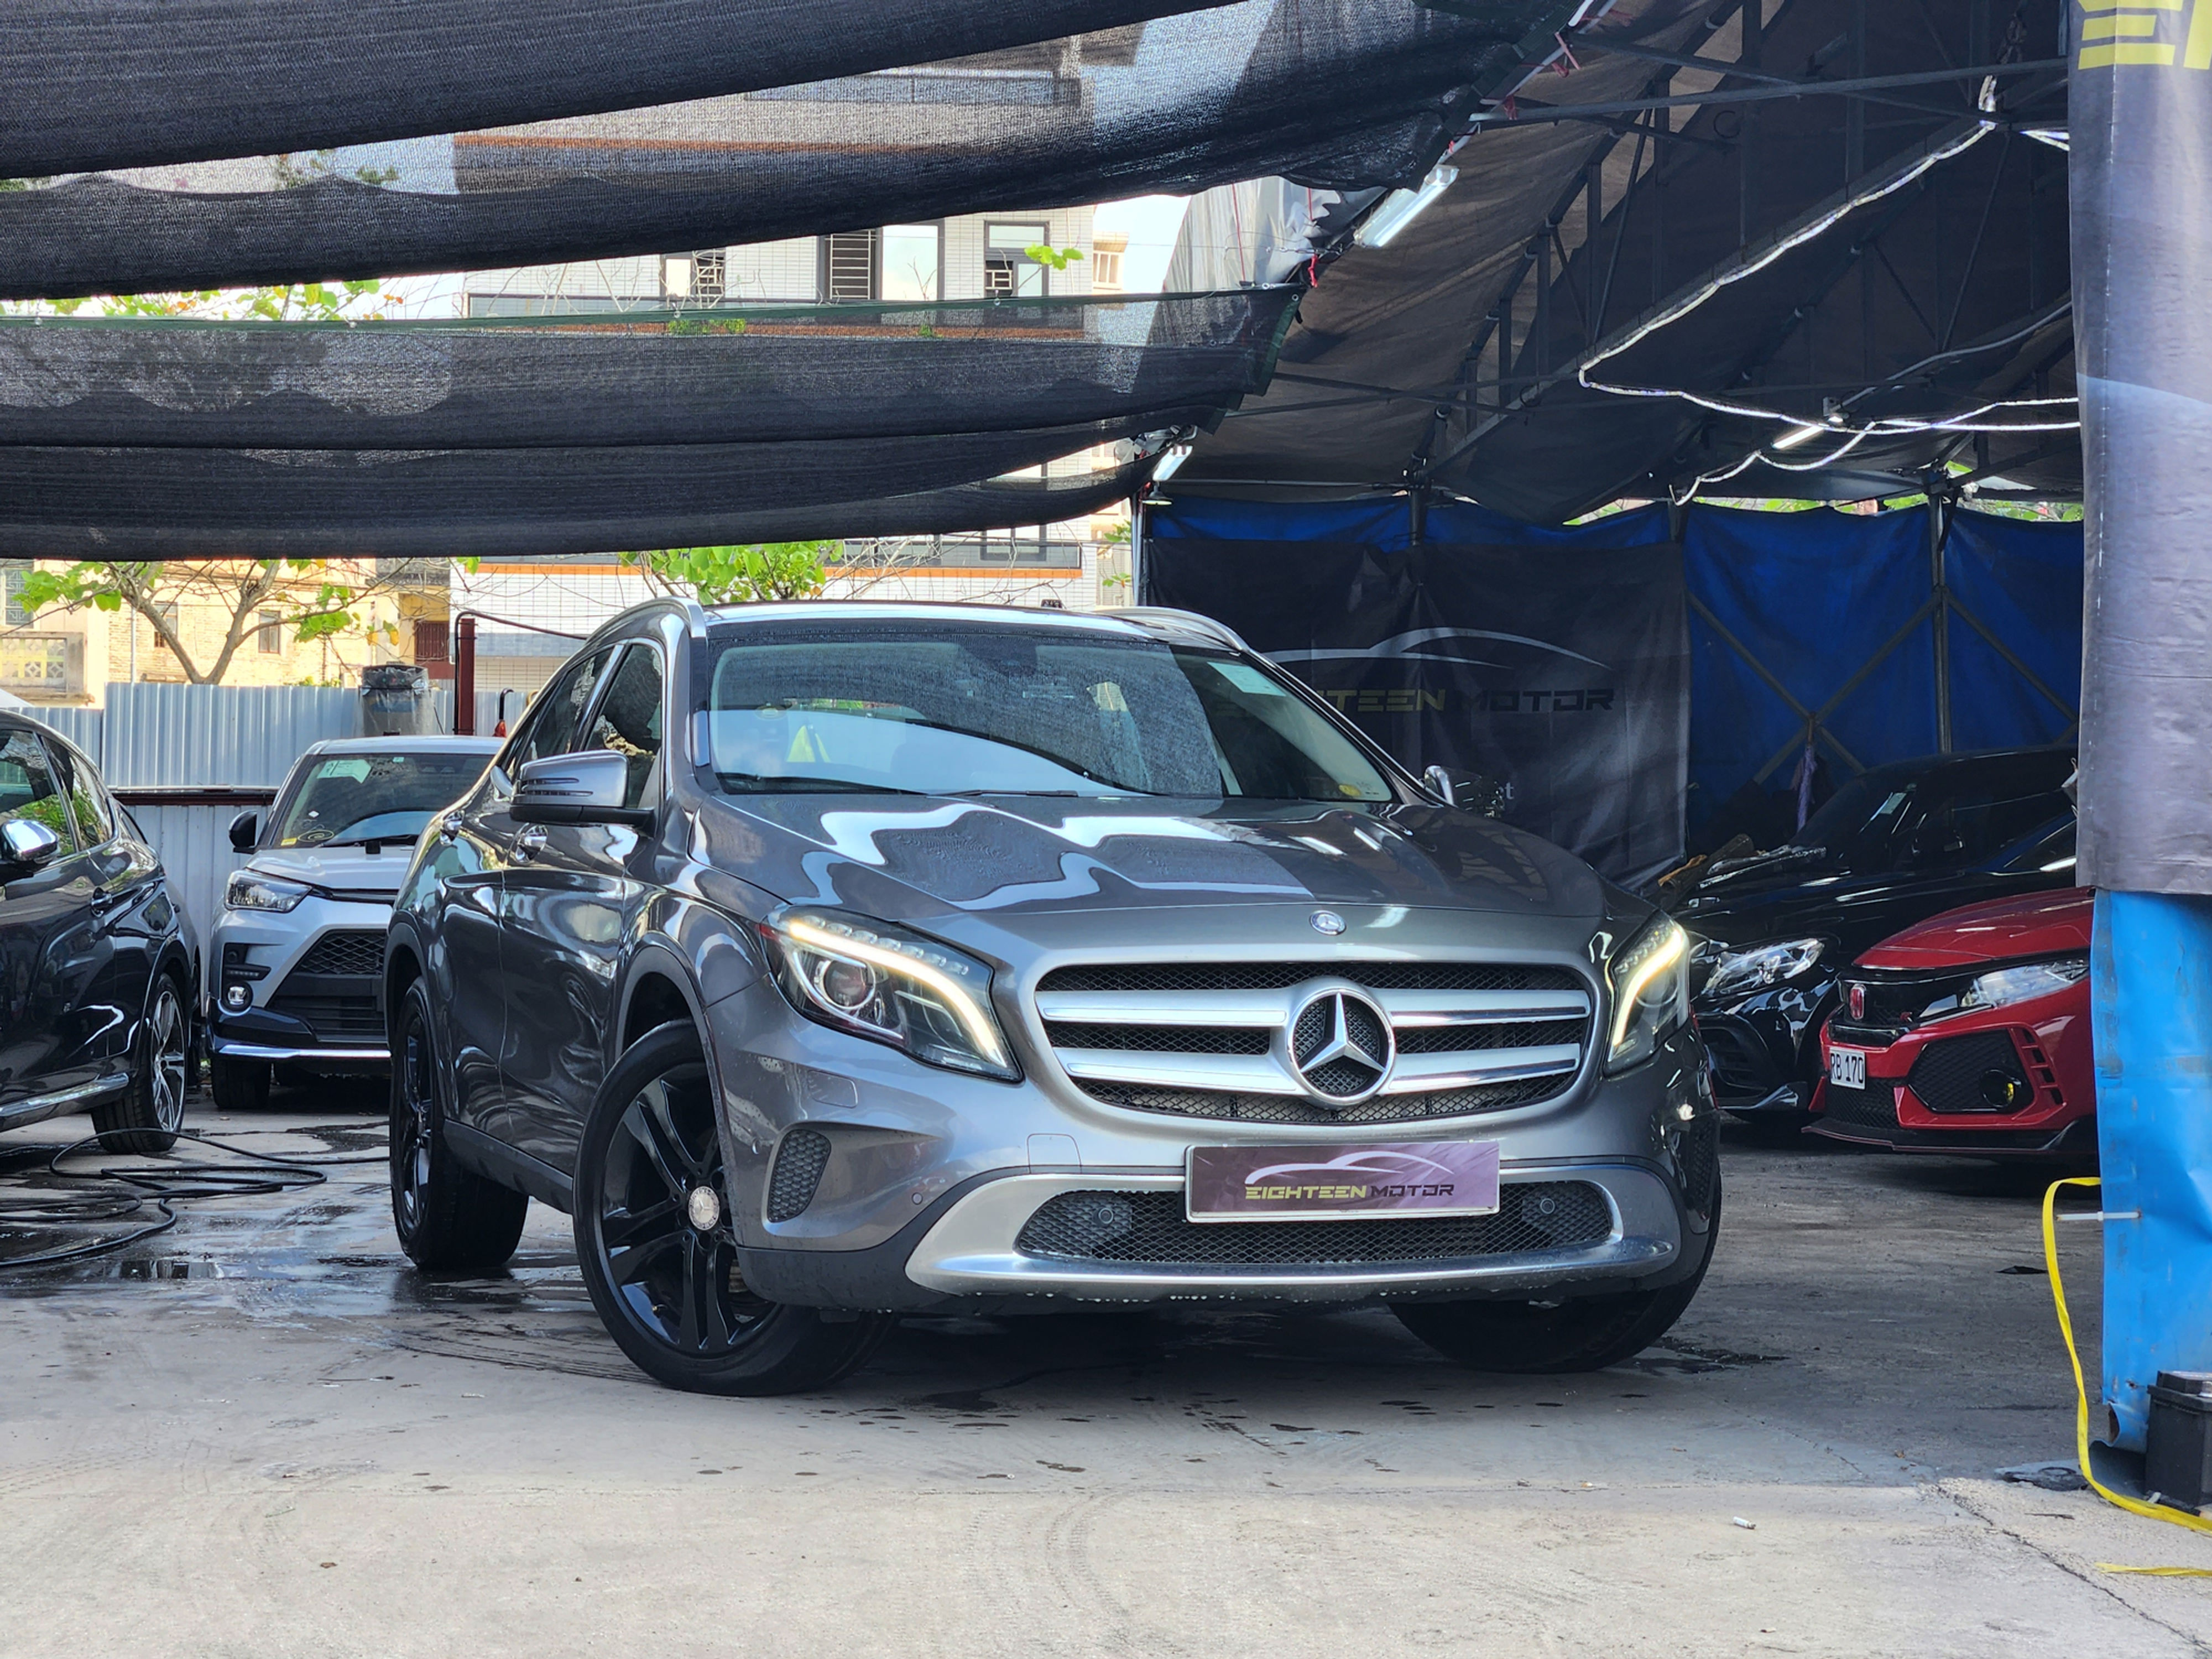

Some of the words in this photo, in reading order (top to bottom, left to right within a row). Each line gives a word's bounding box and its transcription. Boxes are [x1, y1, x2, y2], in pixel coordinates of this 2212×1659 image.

[1317, 689, 1445, 712] TEEN
[1845, 1055, 1864, 1083] 170
[1245, 1185, 1368, 1200] EIGHTEEN
[1371, 1183, 1455, 1198] MOTOR
